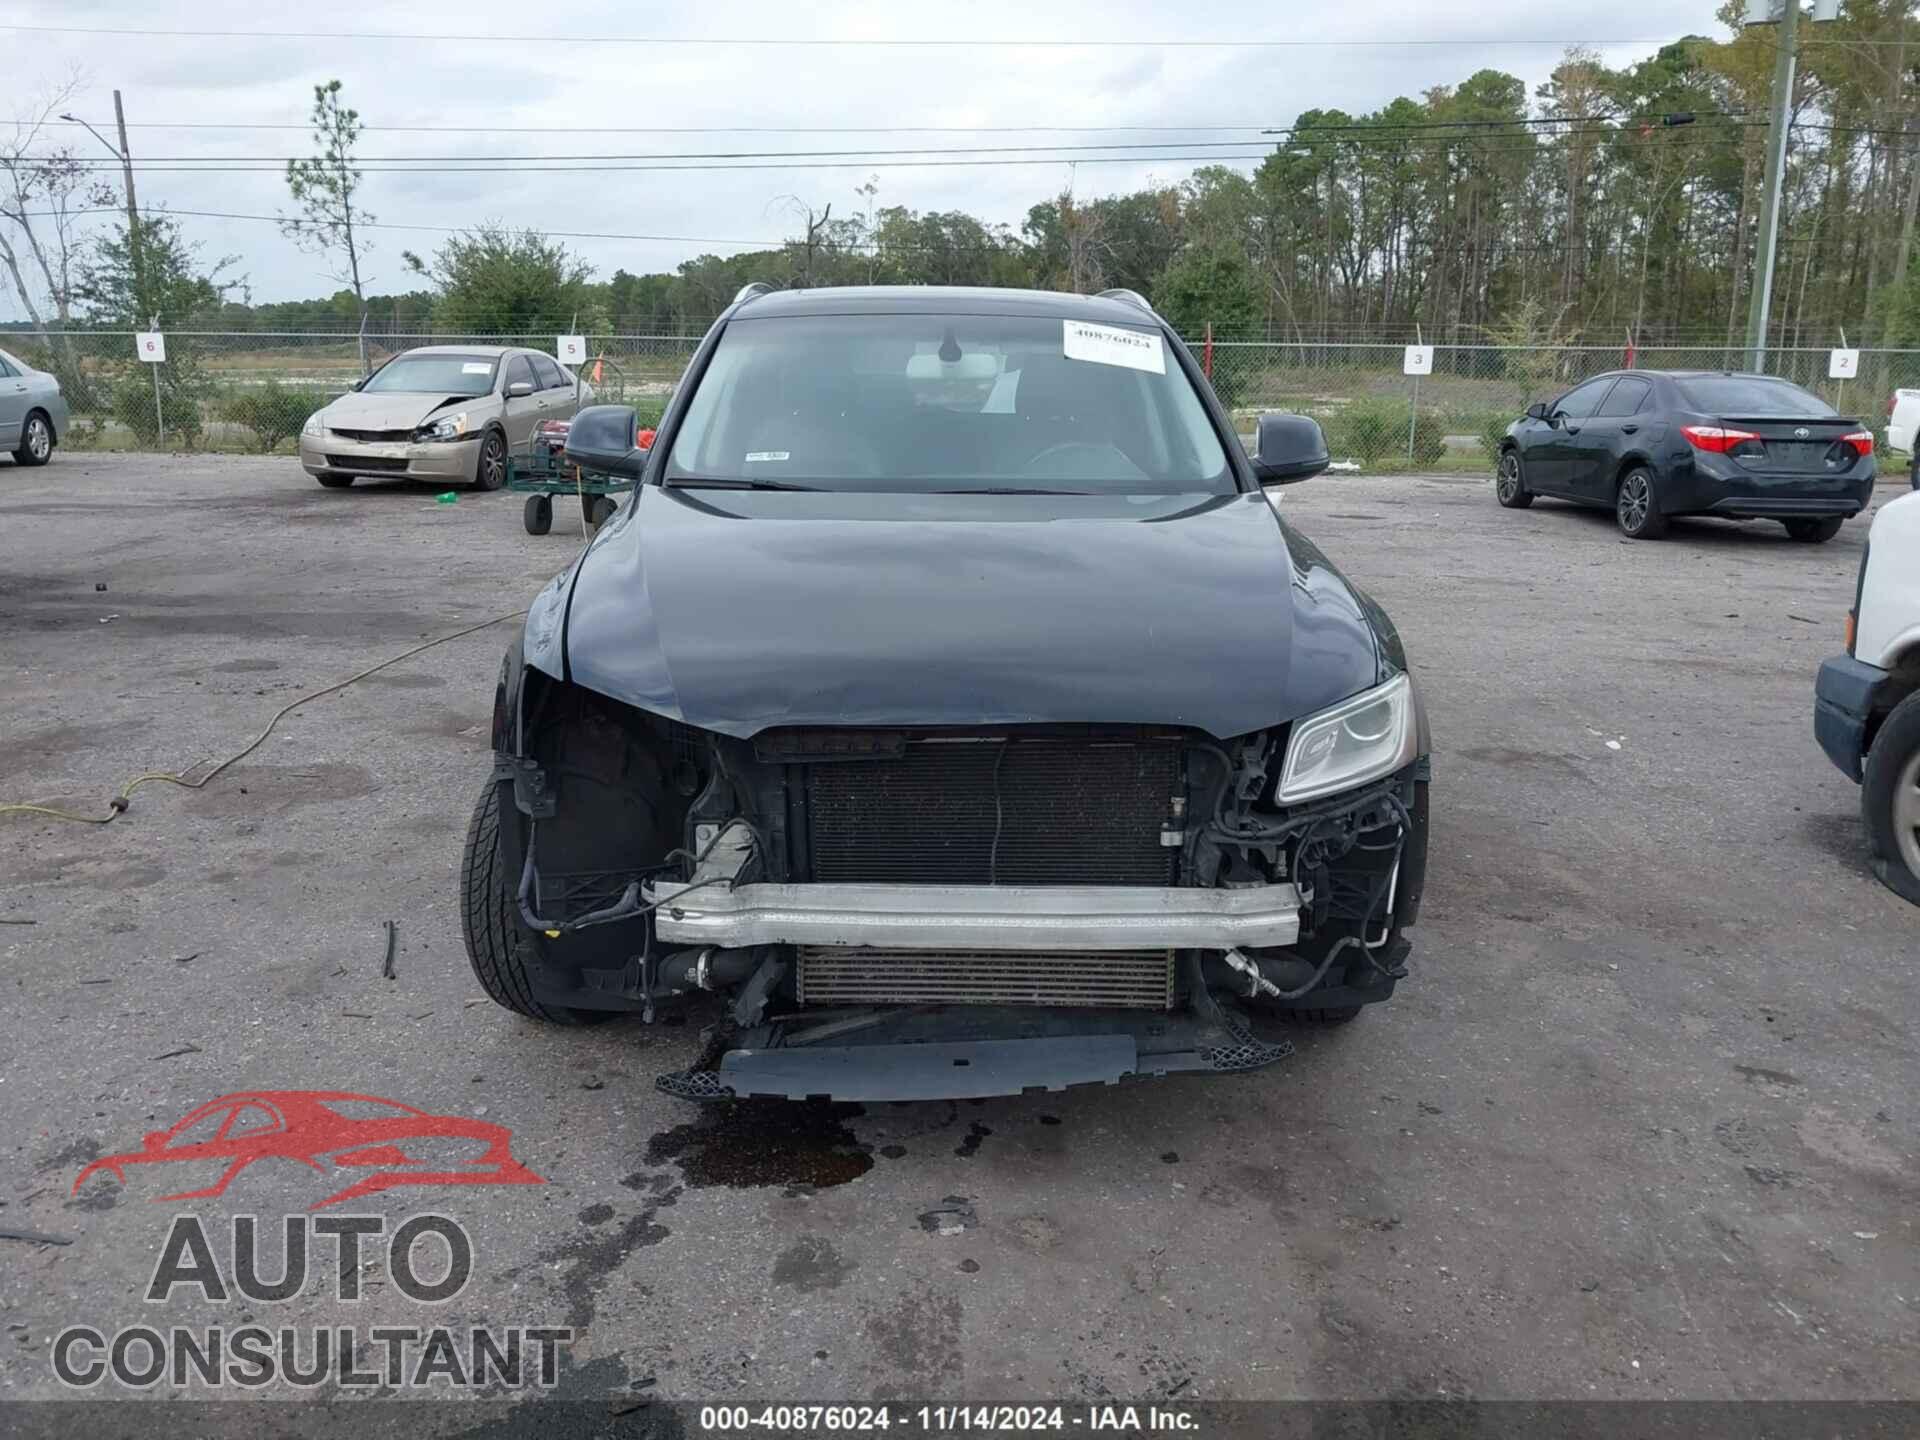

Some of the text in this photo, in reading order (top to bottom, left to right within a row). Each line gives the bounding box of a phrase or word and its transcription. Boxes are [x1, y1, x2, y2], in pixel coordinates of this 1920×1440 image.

[1074, 329, 1151, 349] 40876024
[146, 341, 155, 352] 6
[567, 344, 576, 354] 5
[1414, 354, 1423, 364] 3
[1840, 357, 1849, 368] 2
